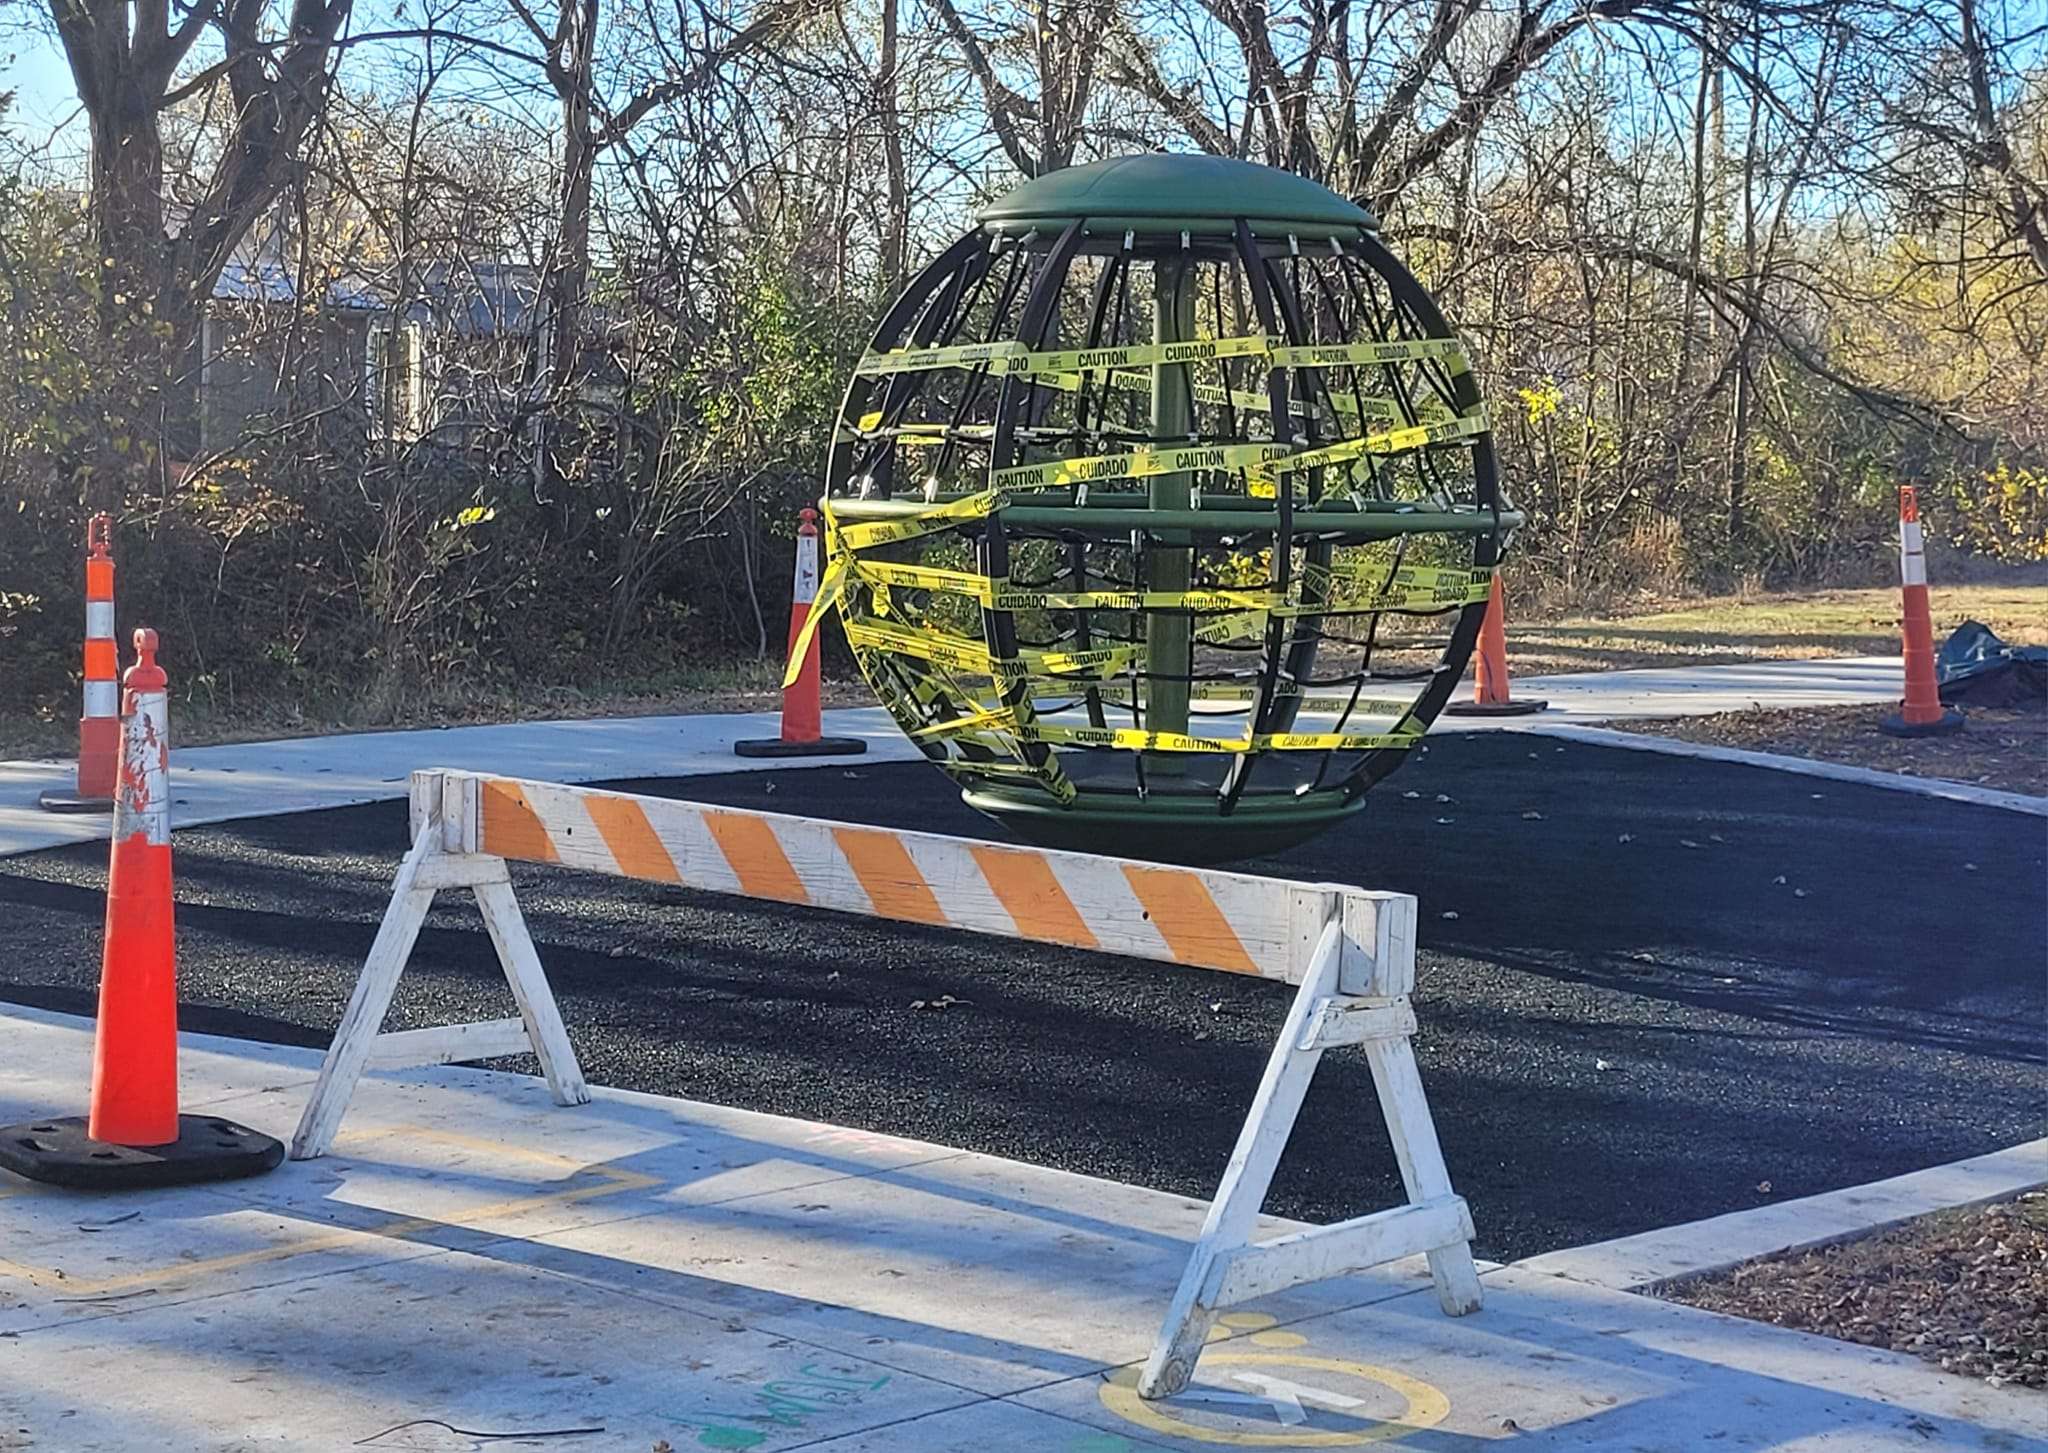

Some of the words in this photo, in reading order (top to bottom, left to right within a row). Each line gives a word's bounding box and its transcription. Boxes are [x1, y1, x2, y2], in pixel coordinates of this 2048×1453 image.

[1078, 350, 1128, 368] CAUTION
[1165, 343, 1217, 361] CUIDADO
[997, 468, 1043, 487] CAUTION
[1079, 458, 1129, 479] CUIDADO
[1176, 450, 1225, 467] CAUTION
[999, 595, 1048, 610] CUIDADO
[1095, 595, 1145, 609] CAUTION
[1181, 595, 1231, 609] CUIDADO
[1063, 650, 1113, 667] CUIDADO
[1075, 732, 1124, 744] CUIDADO
[1173, 737, 1222, 750] CAUTION
